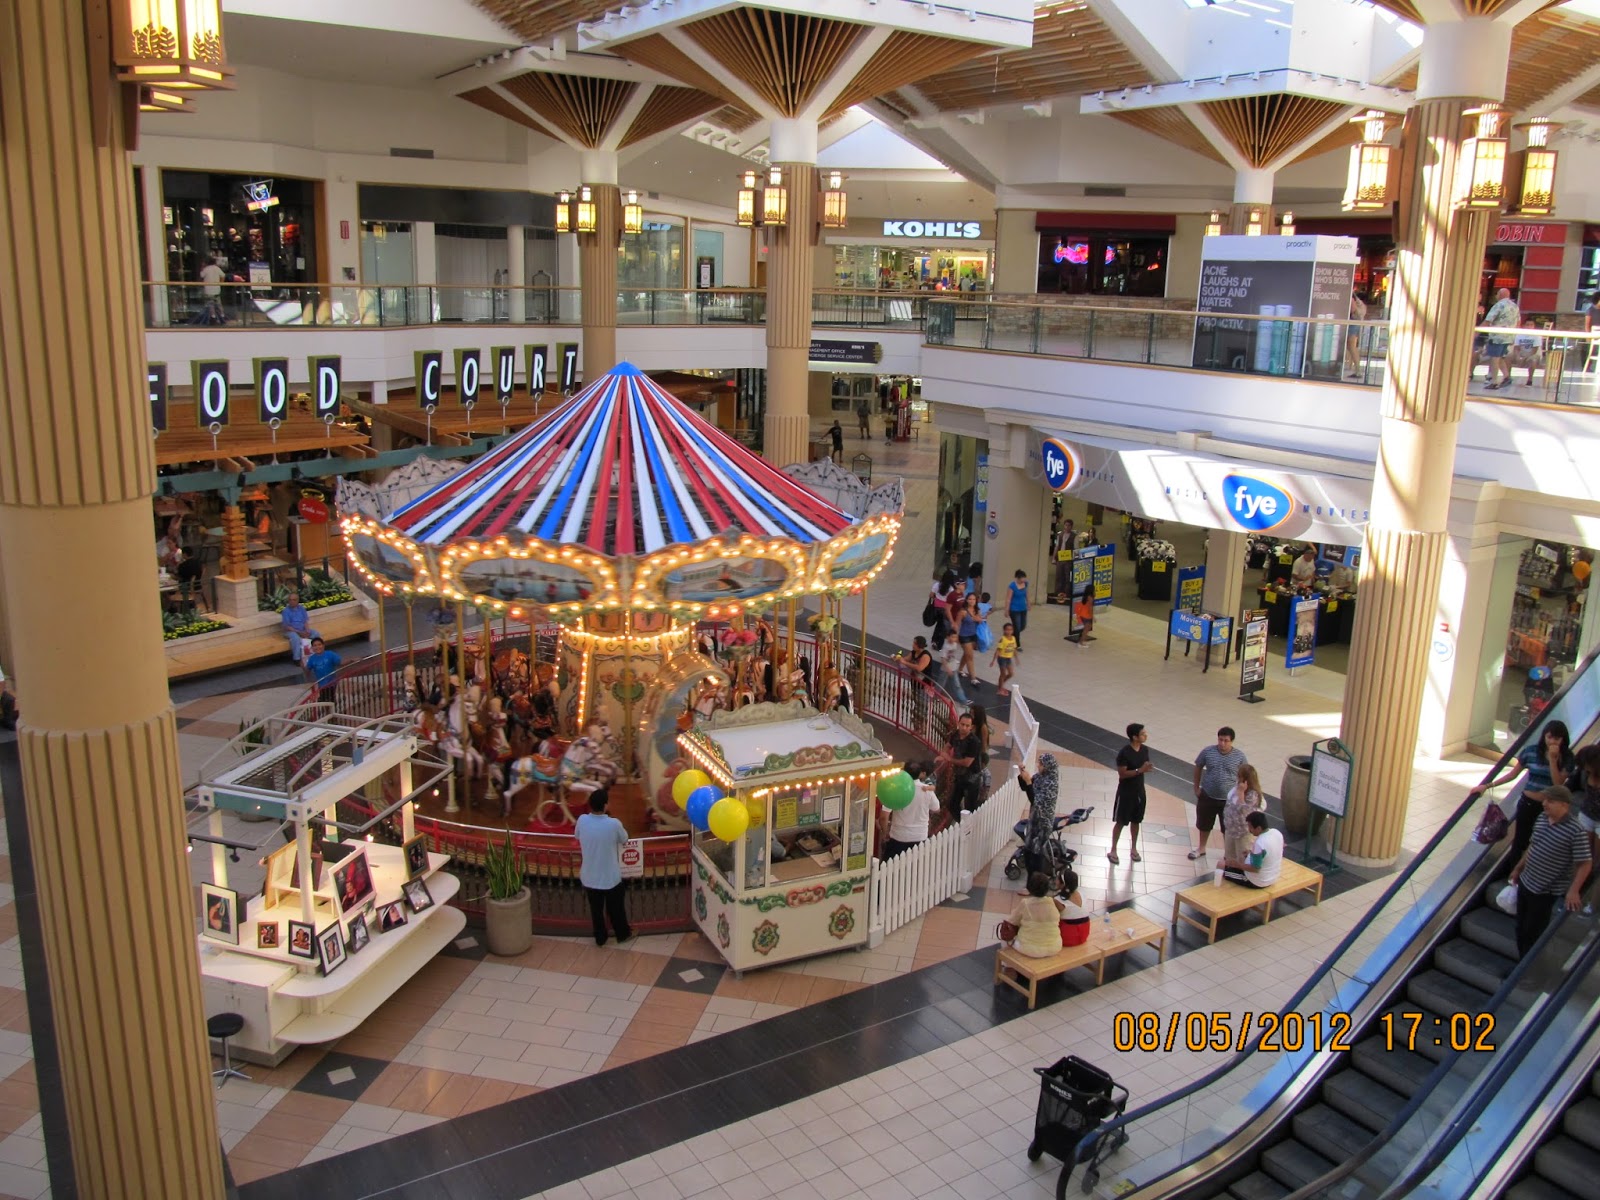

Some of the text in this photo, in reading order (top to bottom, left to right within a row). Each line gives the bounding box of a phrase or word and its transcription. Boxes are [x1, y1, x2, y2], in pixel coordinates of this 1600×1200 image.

[883, 221, 981, 238] KOHL'S
[1496, 225, 1545, 242] OBIN
[1286, 240, 1312, 249] proactiv
[1333, 242, 1353, 250] proactiv
[1203, 265, 1229, 276] ACNE
[1315, 268, 1348, 277] SHOW ACNE
[1203, 277, 1253, 287] LAUGHS AT
[1201, 287, 1248, 298] SOAP AND
[1200, 297, 1233, 308] WATER.
[424, 351, 576, 400] COURT
[1046, 450, 1065, 478] fye
[1234, 486, 1277, 519] fye
[1302, 504, 1369, 519] MOVIES
[1180, 614, 1202, 626] Movies
